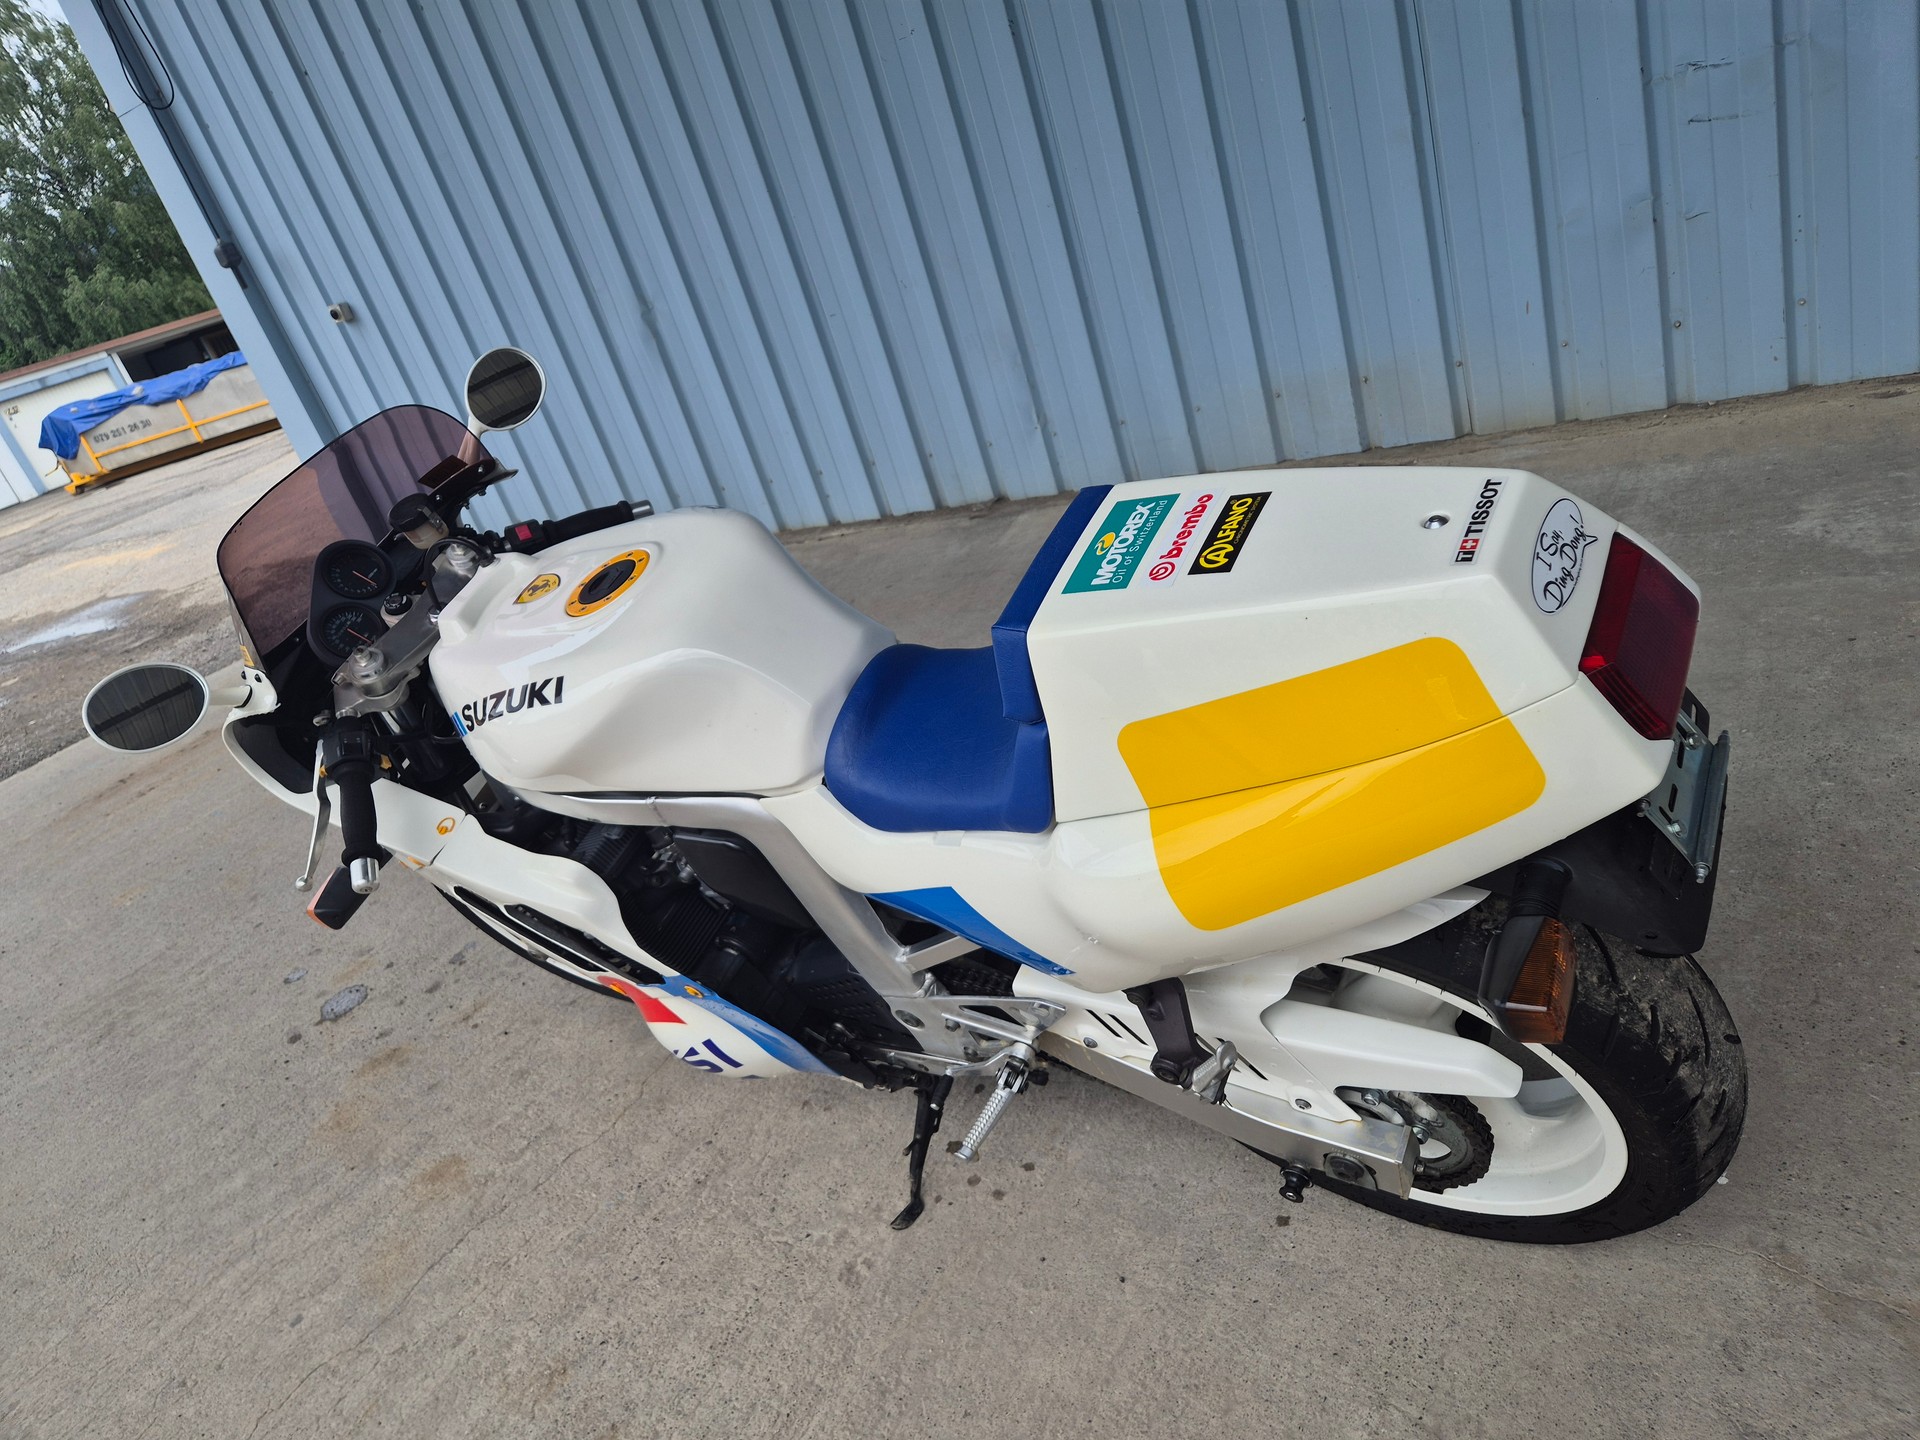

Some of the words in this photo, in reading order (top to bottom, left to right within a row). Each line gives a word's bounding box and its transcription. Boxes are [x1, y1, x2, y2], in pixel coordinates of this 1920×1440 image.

[1129, 500, 1168, 552] Switzerland
[1159, 494, 1213, 559] brembo
[1199, 497, 1253, 568] ALFANO
[1464, 479, 1502, 537] TISSOT
[1091, 502, 1156, 585] MOTOREX
[1124, 555, 1135, 566] of
[1536, 552, 1552, 571] I
[1543, 567, 1574, 610] Ding
[1560, 514, 1584, 569] Dong!
[1112, 568, 1127, 583] Oil
[462, 676, 564, 732] SUZUKI
